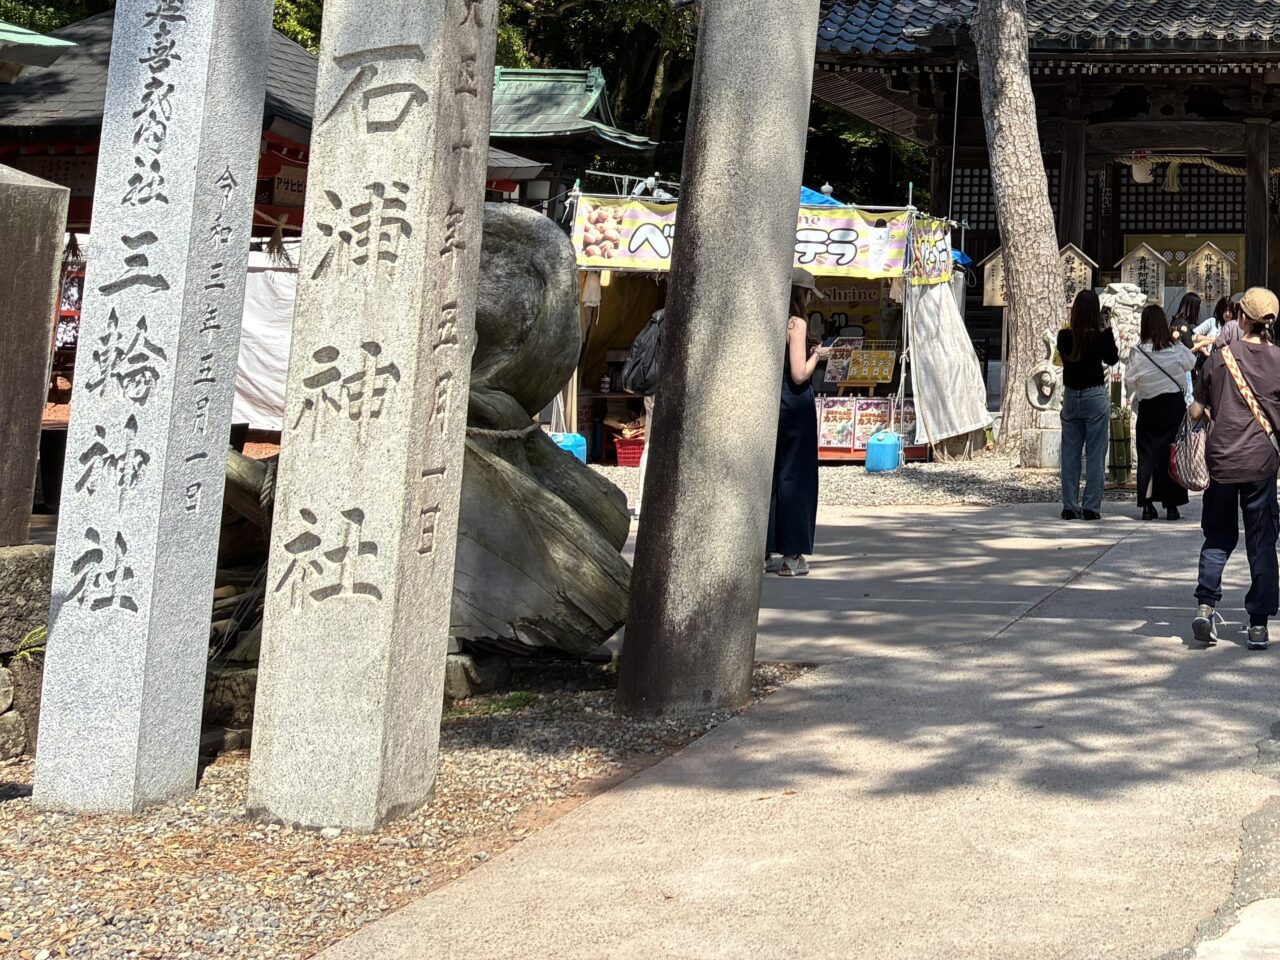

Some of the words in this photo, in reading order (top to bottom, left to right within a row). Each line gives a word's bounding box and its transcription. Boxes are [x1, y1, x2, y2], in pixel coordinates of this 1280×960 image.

[184, 165, 238, 515] 令和三年五月一日
[823, 287, 877, 302] Shrine
